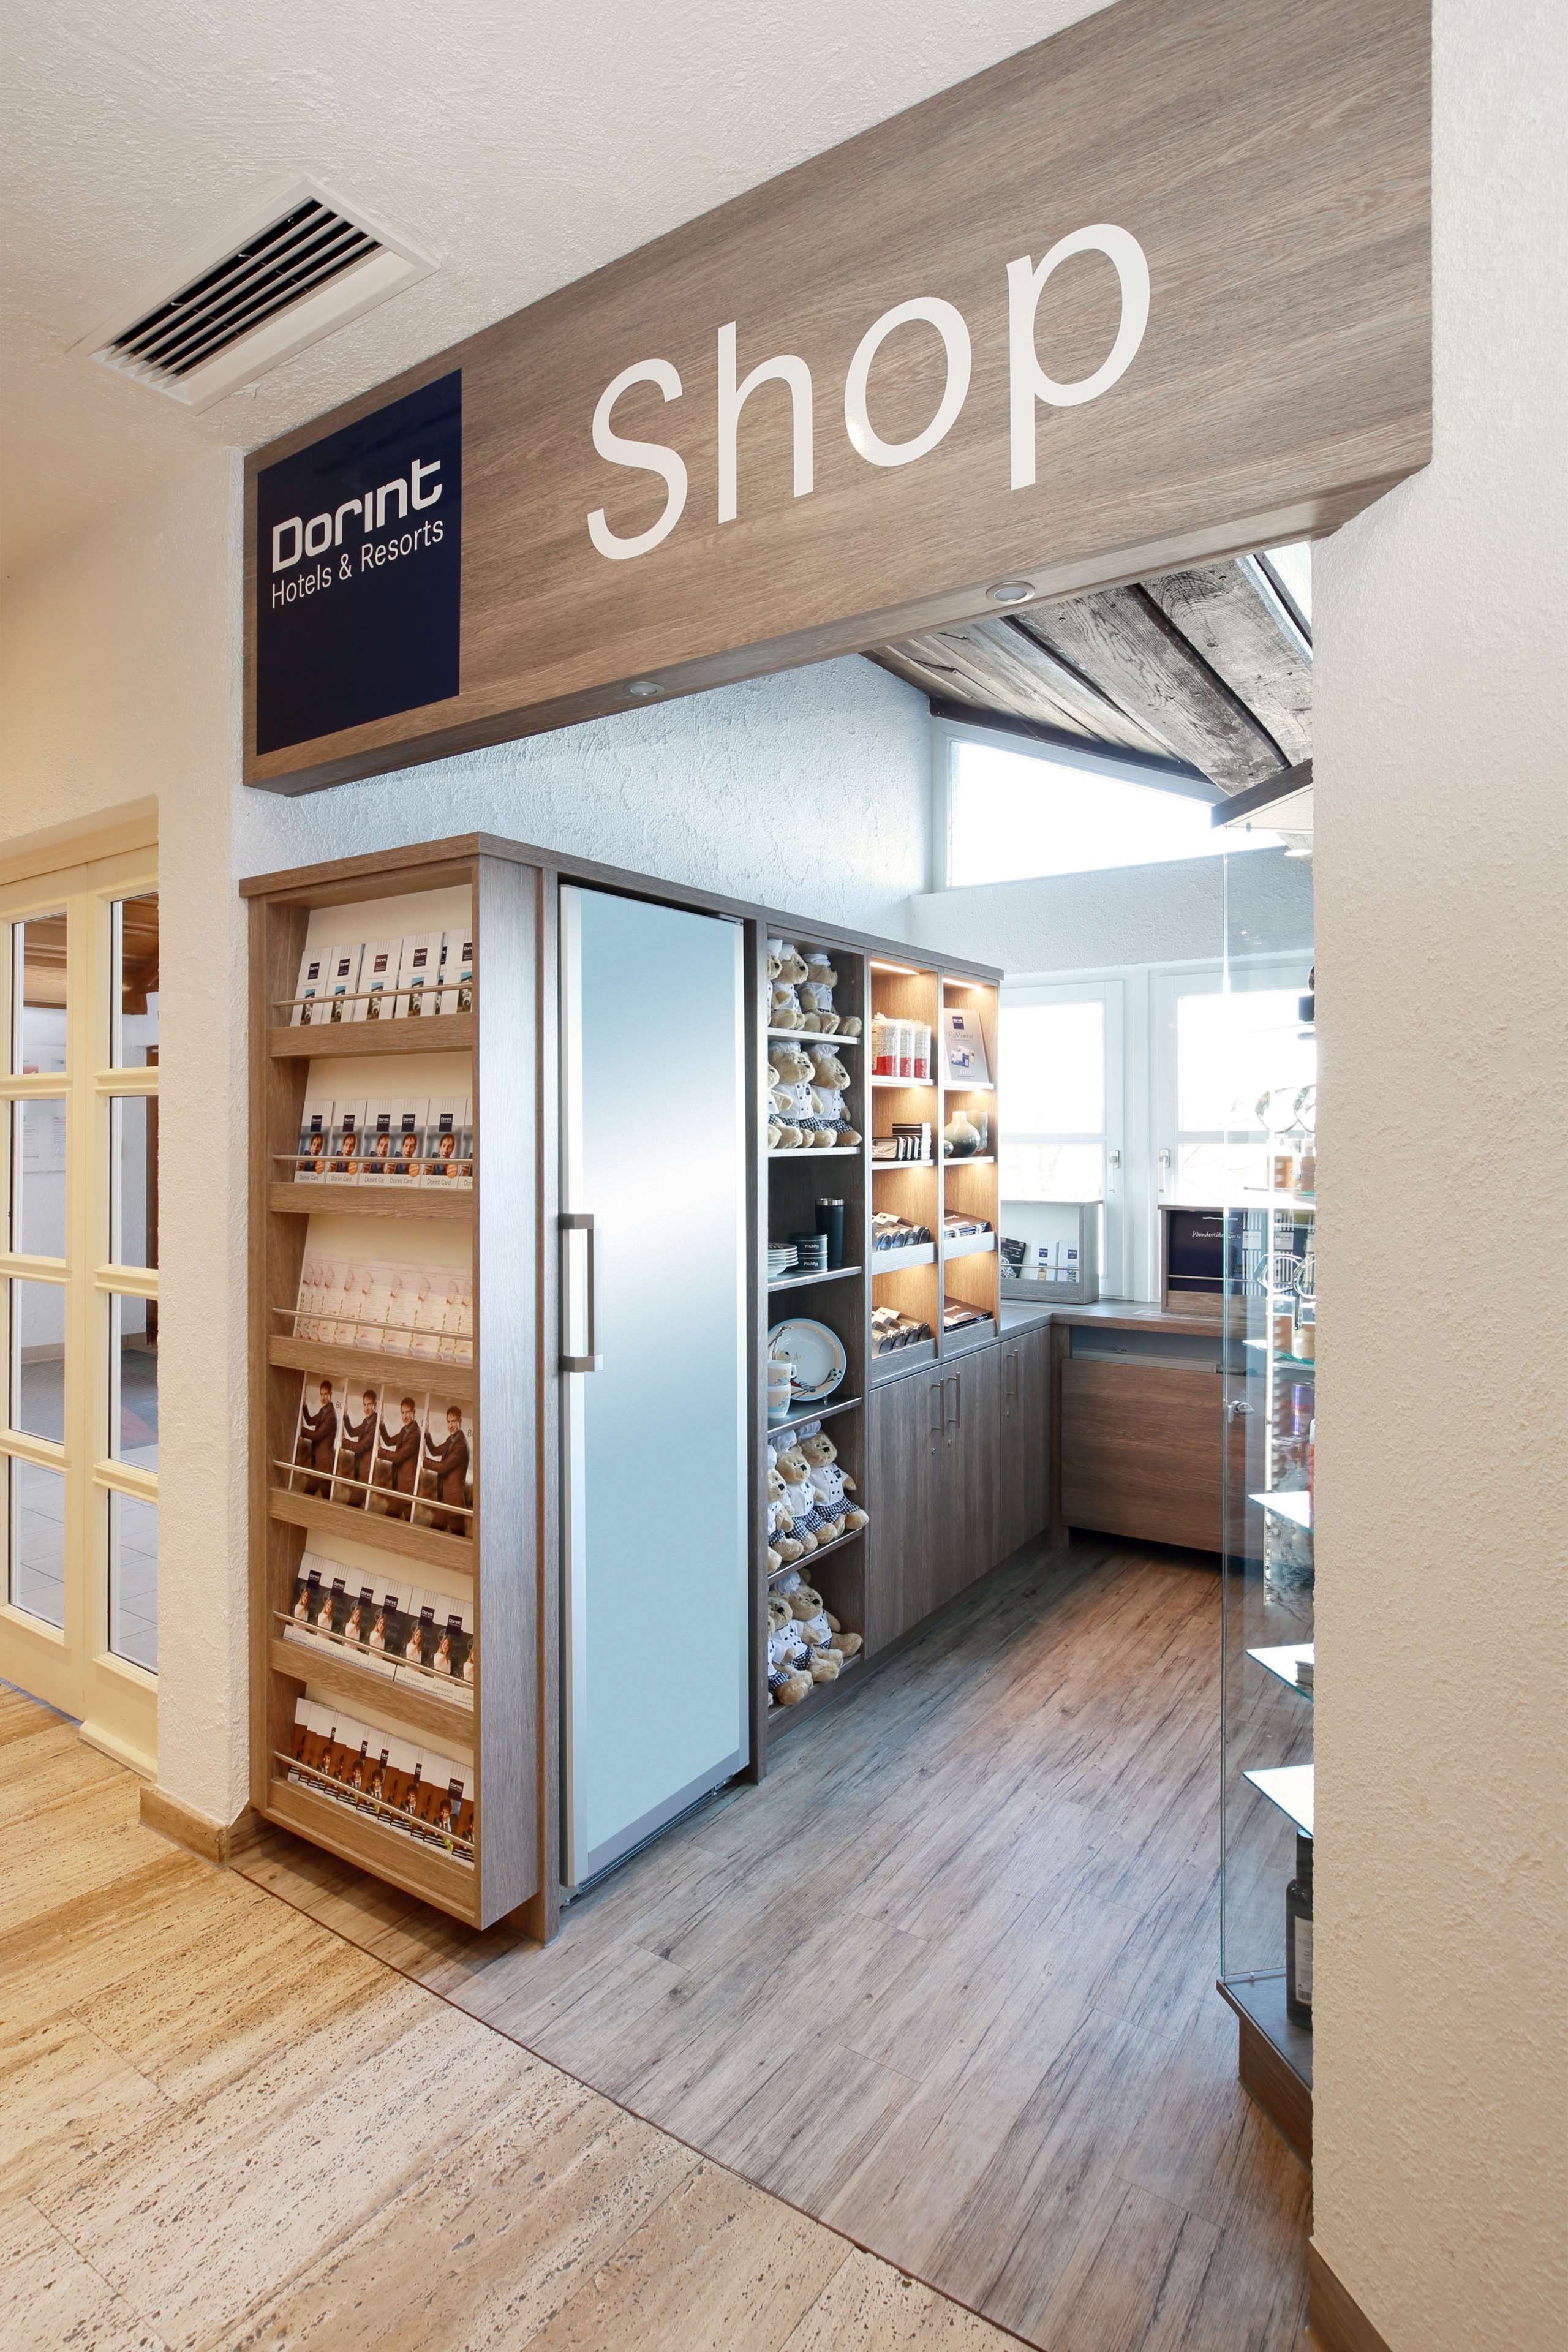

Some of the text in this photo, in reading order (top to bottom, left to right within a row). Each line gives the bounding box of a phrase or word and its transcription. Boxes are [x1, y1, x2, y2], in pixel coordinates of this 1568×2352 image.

[587, 224, 1150, 559] shop
[272, 459, 443, 573] Dorint
[273, 520, 443, 609] Hotels & Resorts
